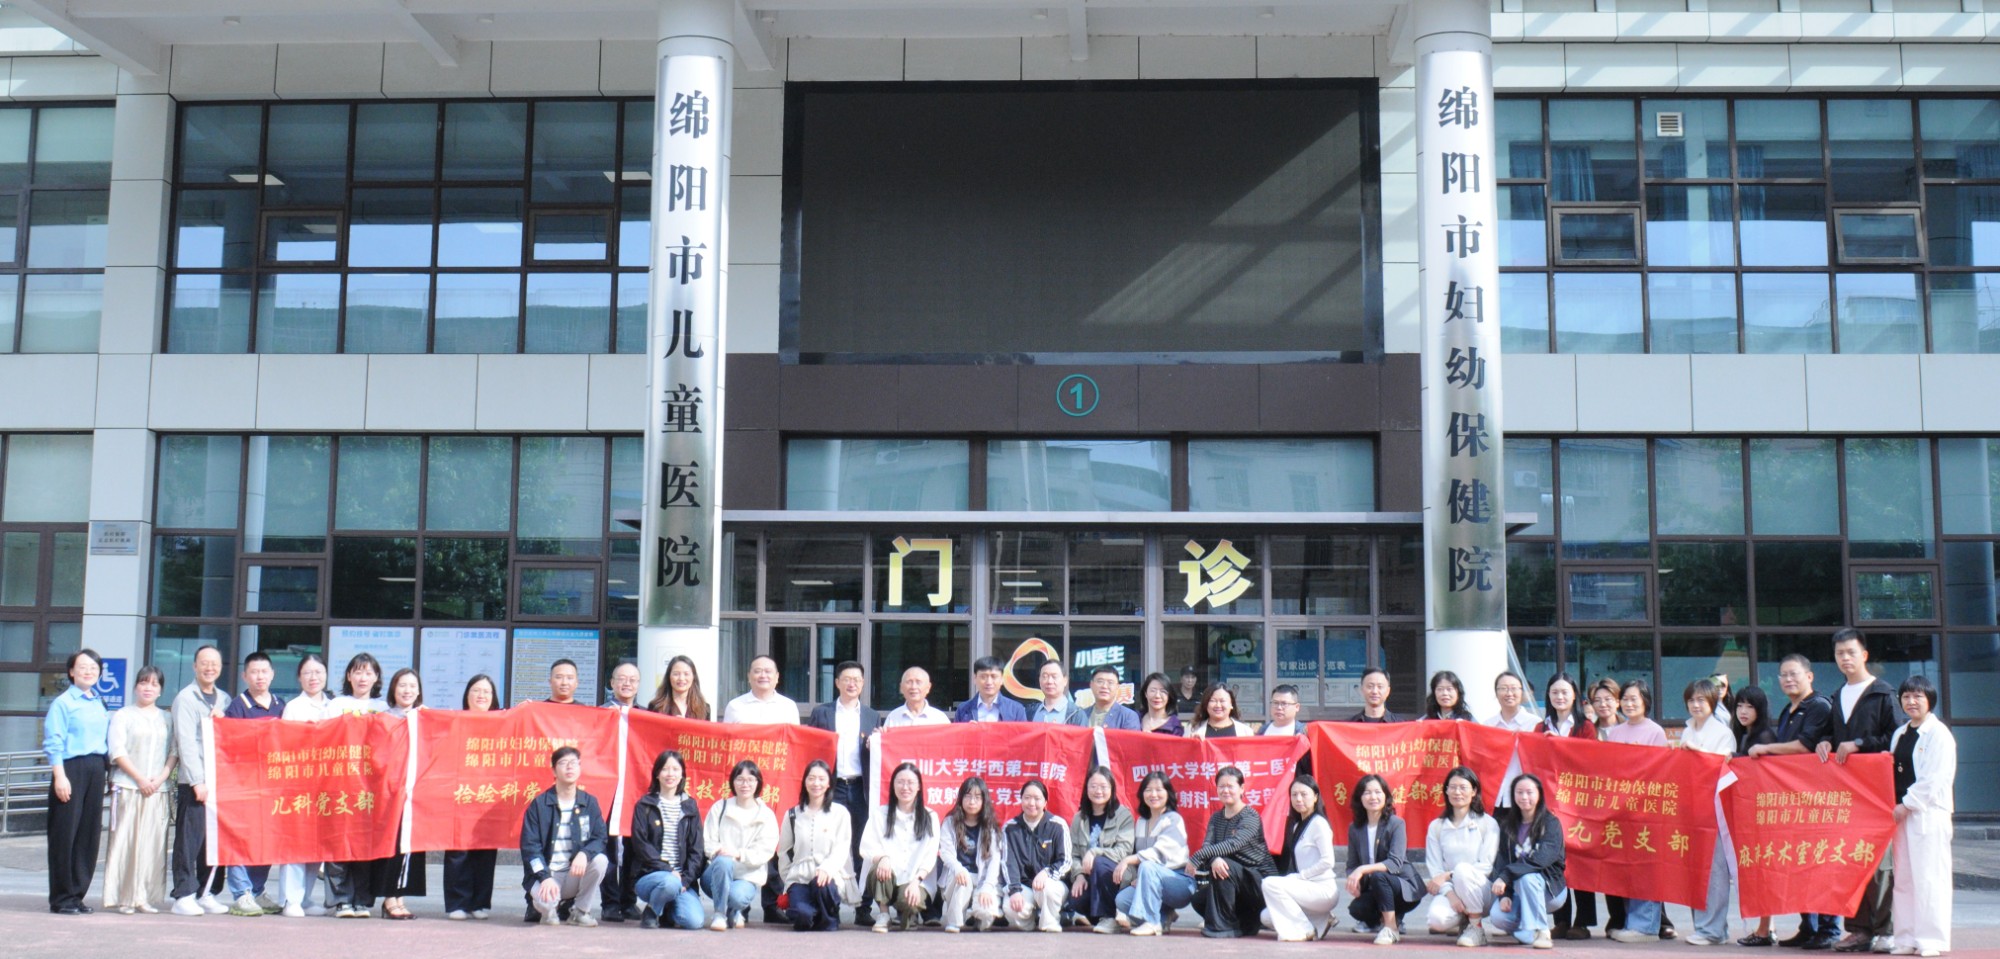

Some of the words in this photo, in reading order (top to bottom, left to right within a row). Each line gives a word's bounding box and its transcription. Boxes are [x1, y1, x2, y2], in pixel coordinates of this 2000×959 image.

[657, 92, 709, 588] 绵阳市儿童医院
[1438, 86, 1492, 593] 绵阳市妇幼保健院
[1074, 645, 1124, 668] 小医生
[678, 733, 788, 756] 绵阳市妇幼保健院
[465, 753, 552, 768] 绵阳市儿童
[901, 758, 1067, 782] 川大学华西第二医院
[454, 781, 585, 806] 检验科党
[1559, 771, 1679, 798] 绵阳市妇幼保健院
[271, 792, 374, 816] 儿科党支部
[1556, 788, 1678, 816] 绵阳市儿童医院
[1756, 790, 1852, 808] 绵阳市妇幼保健院
[1756, 808, 1850, 825] 绵阳市儿童医院
